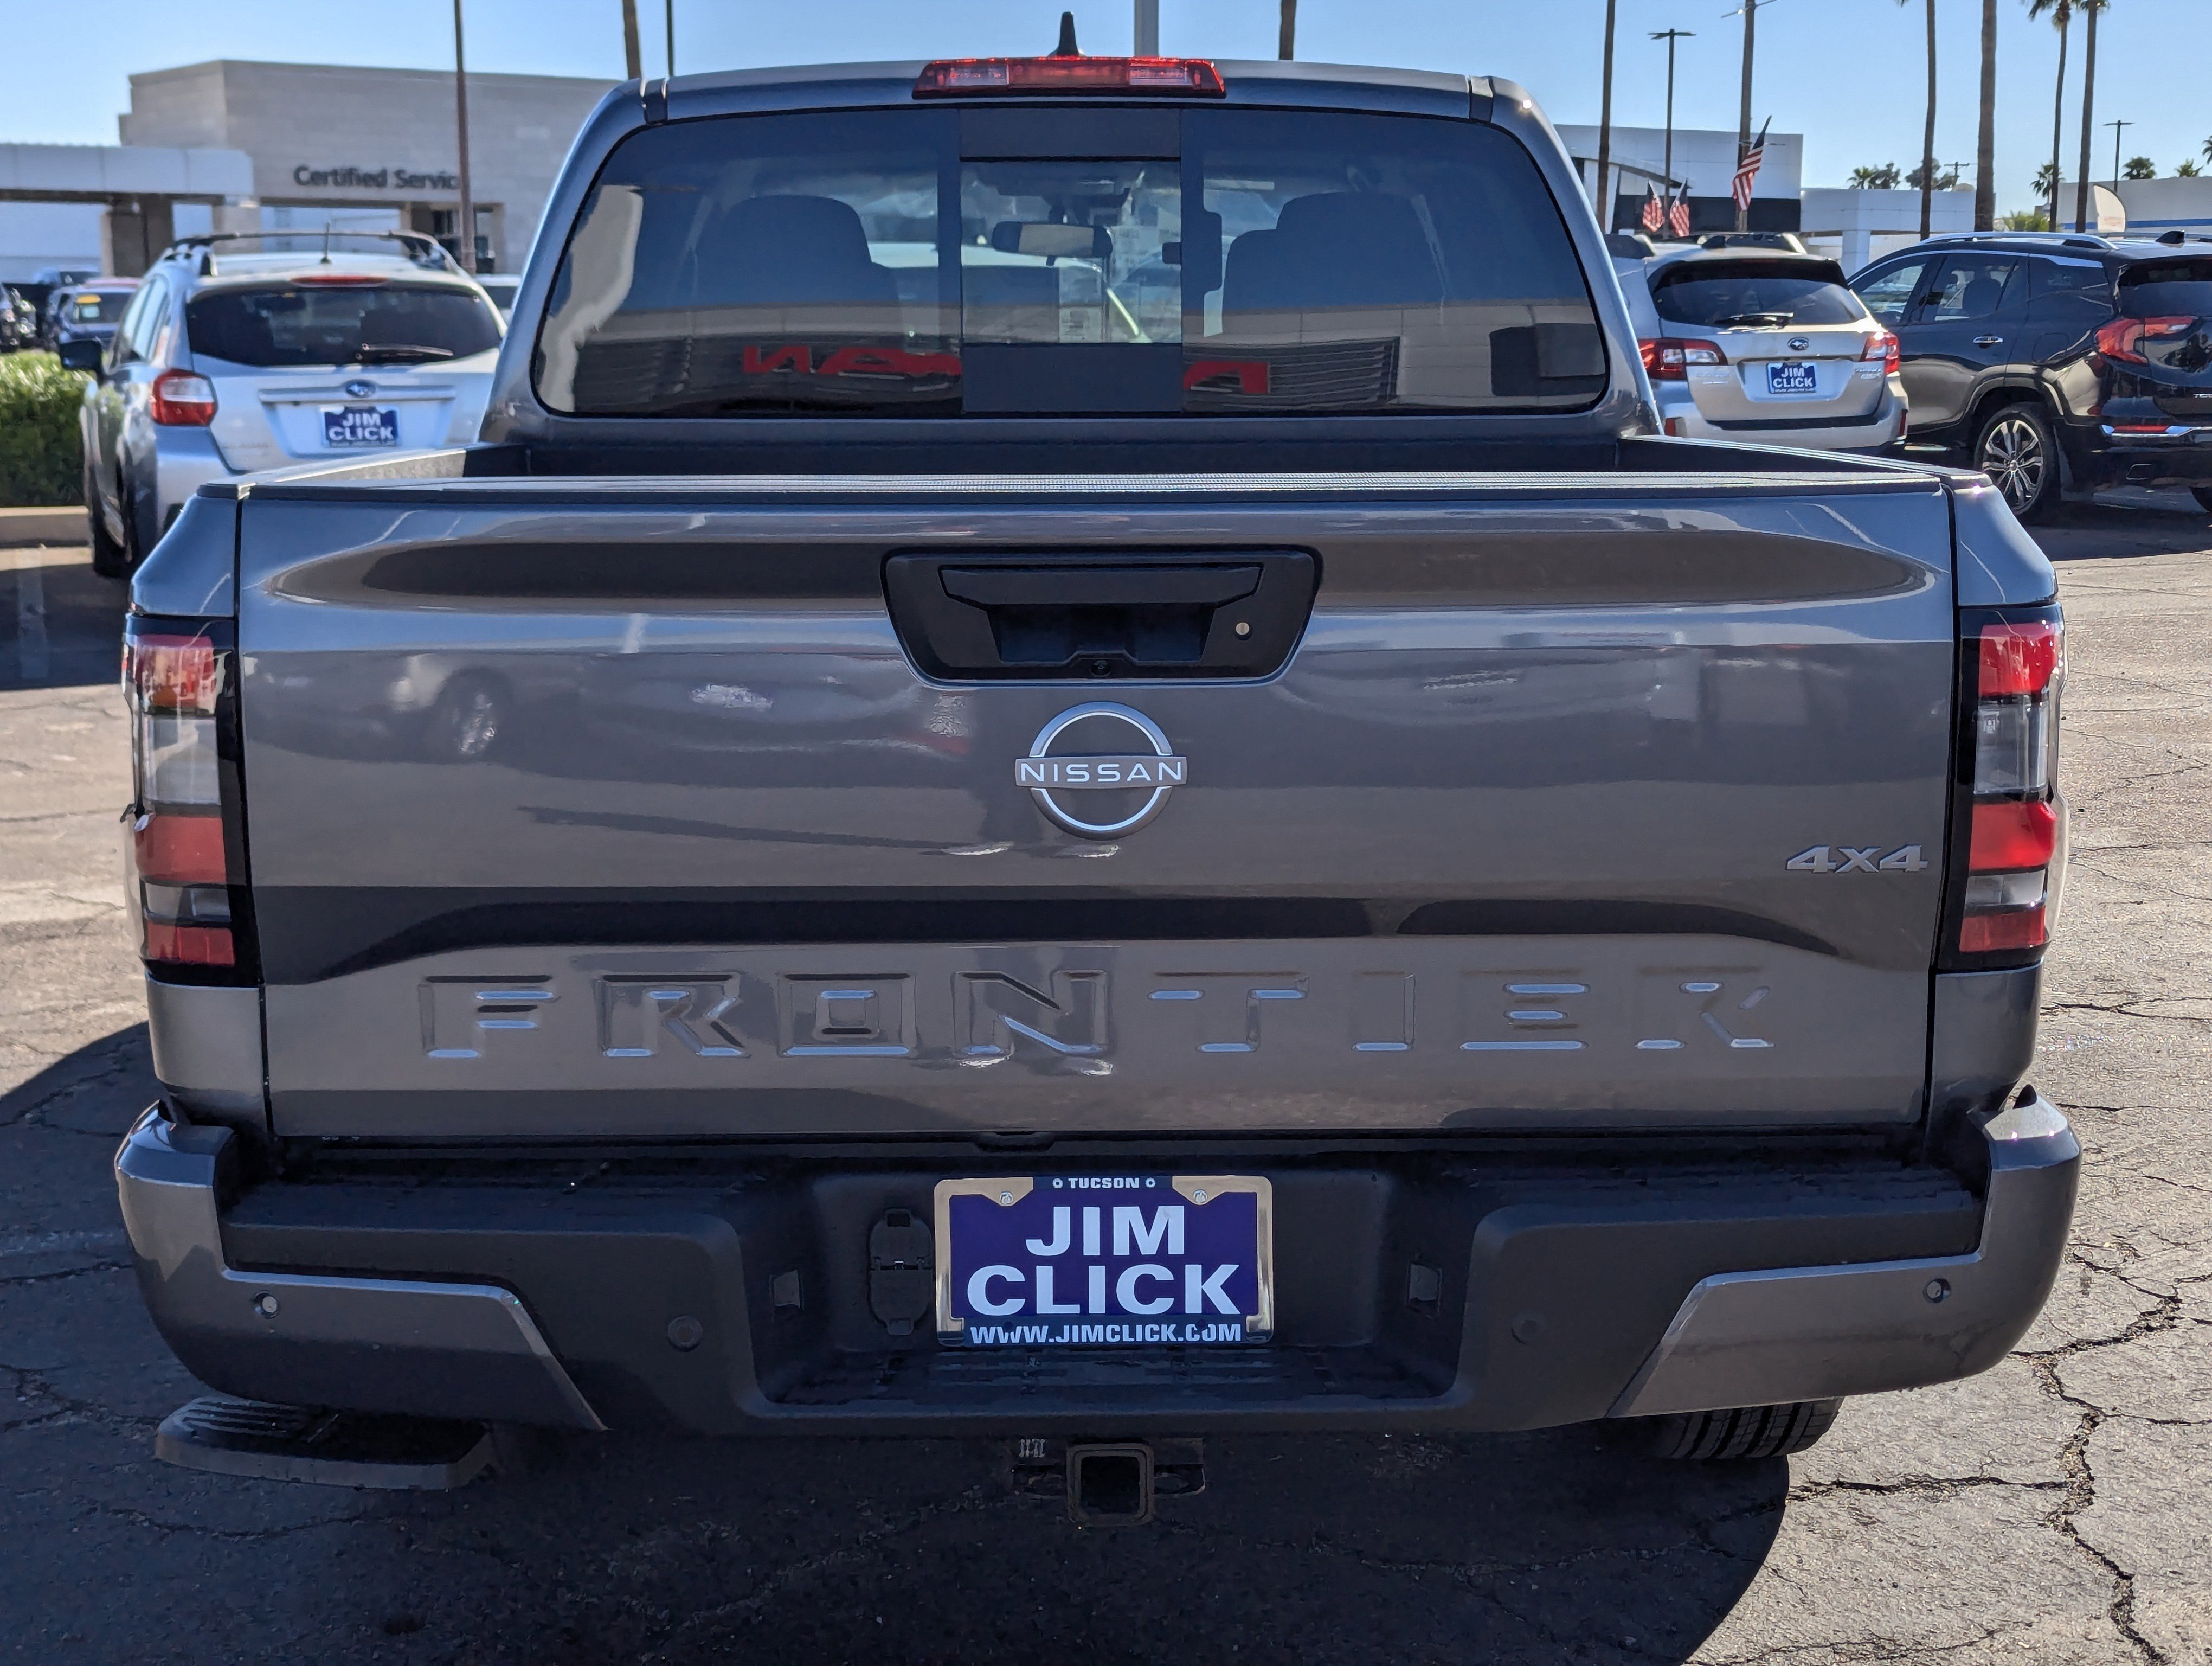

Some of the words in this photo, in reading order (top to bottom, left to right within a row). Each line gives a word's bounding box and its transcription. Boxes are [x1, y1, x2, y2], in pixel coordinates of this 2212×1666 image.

[294, 165, 388, 188] Certified
[394, 169, 459, 189] Servic
[1773, 377, 1813, 388] CLICK
[1781, 367, 1805, 377] JIM
[342, 412, 381, 426] JIM
[329, 426, 395, 441] CLICK
[1020, 761, 1181, 783] NISSAN
[419, 967, 1774, 1059] FRONTIER
[1068, 1177, 1140, 1189] TUCSON
[1025, 1206, 1185, 1256] JIM
[967, 1264, 1241, 1316] CLICK
[970, 1323, 1242, 1344] WWW.JIMCLICK.COM
